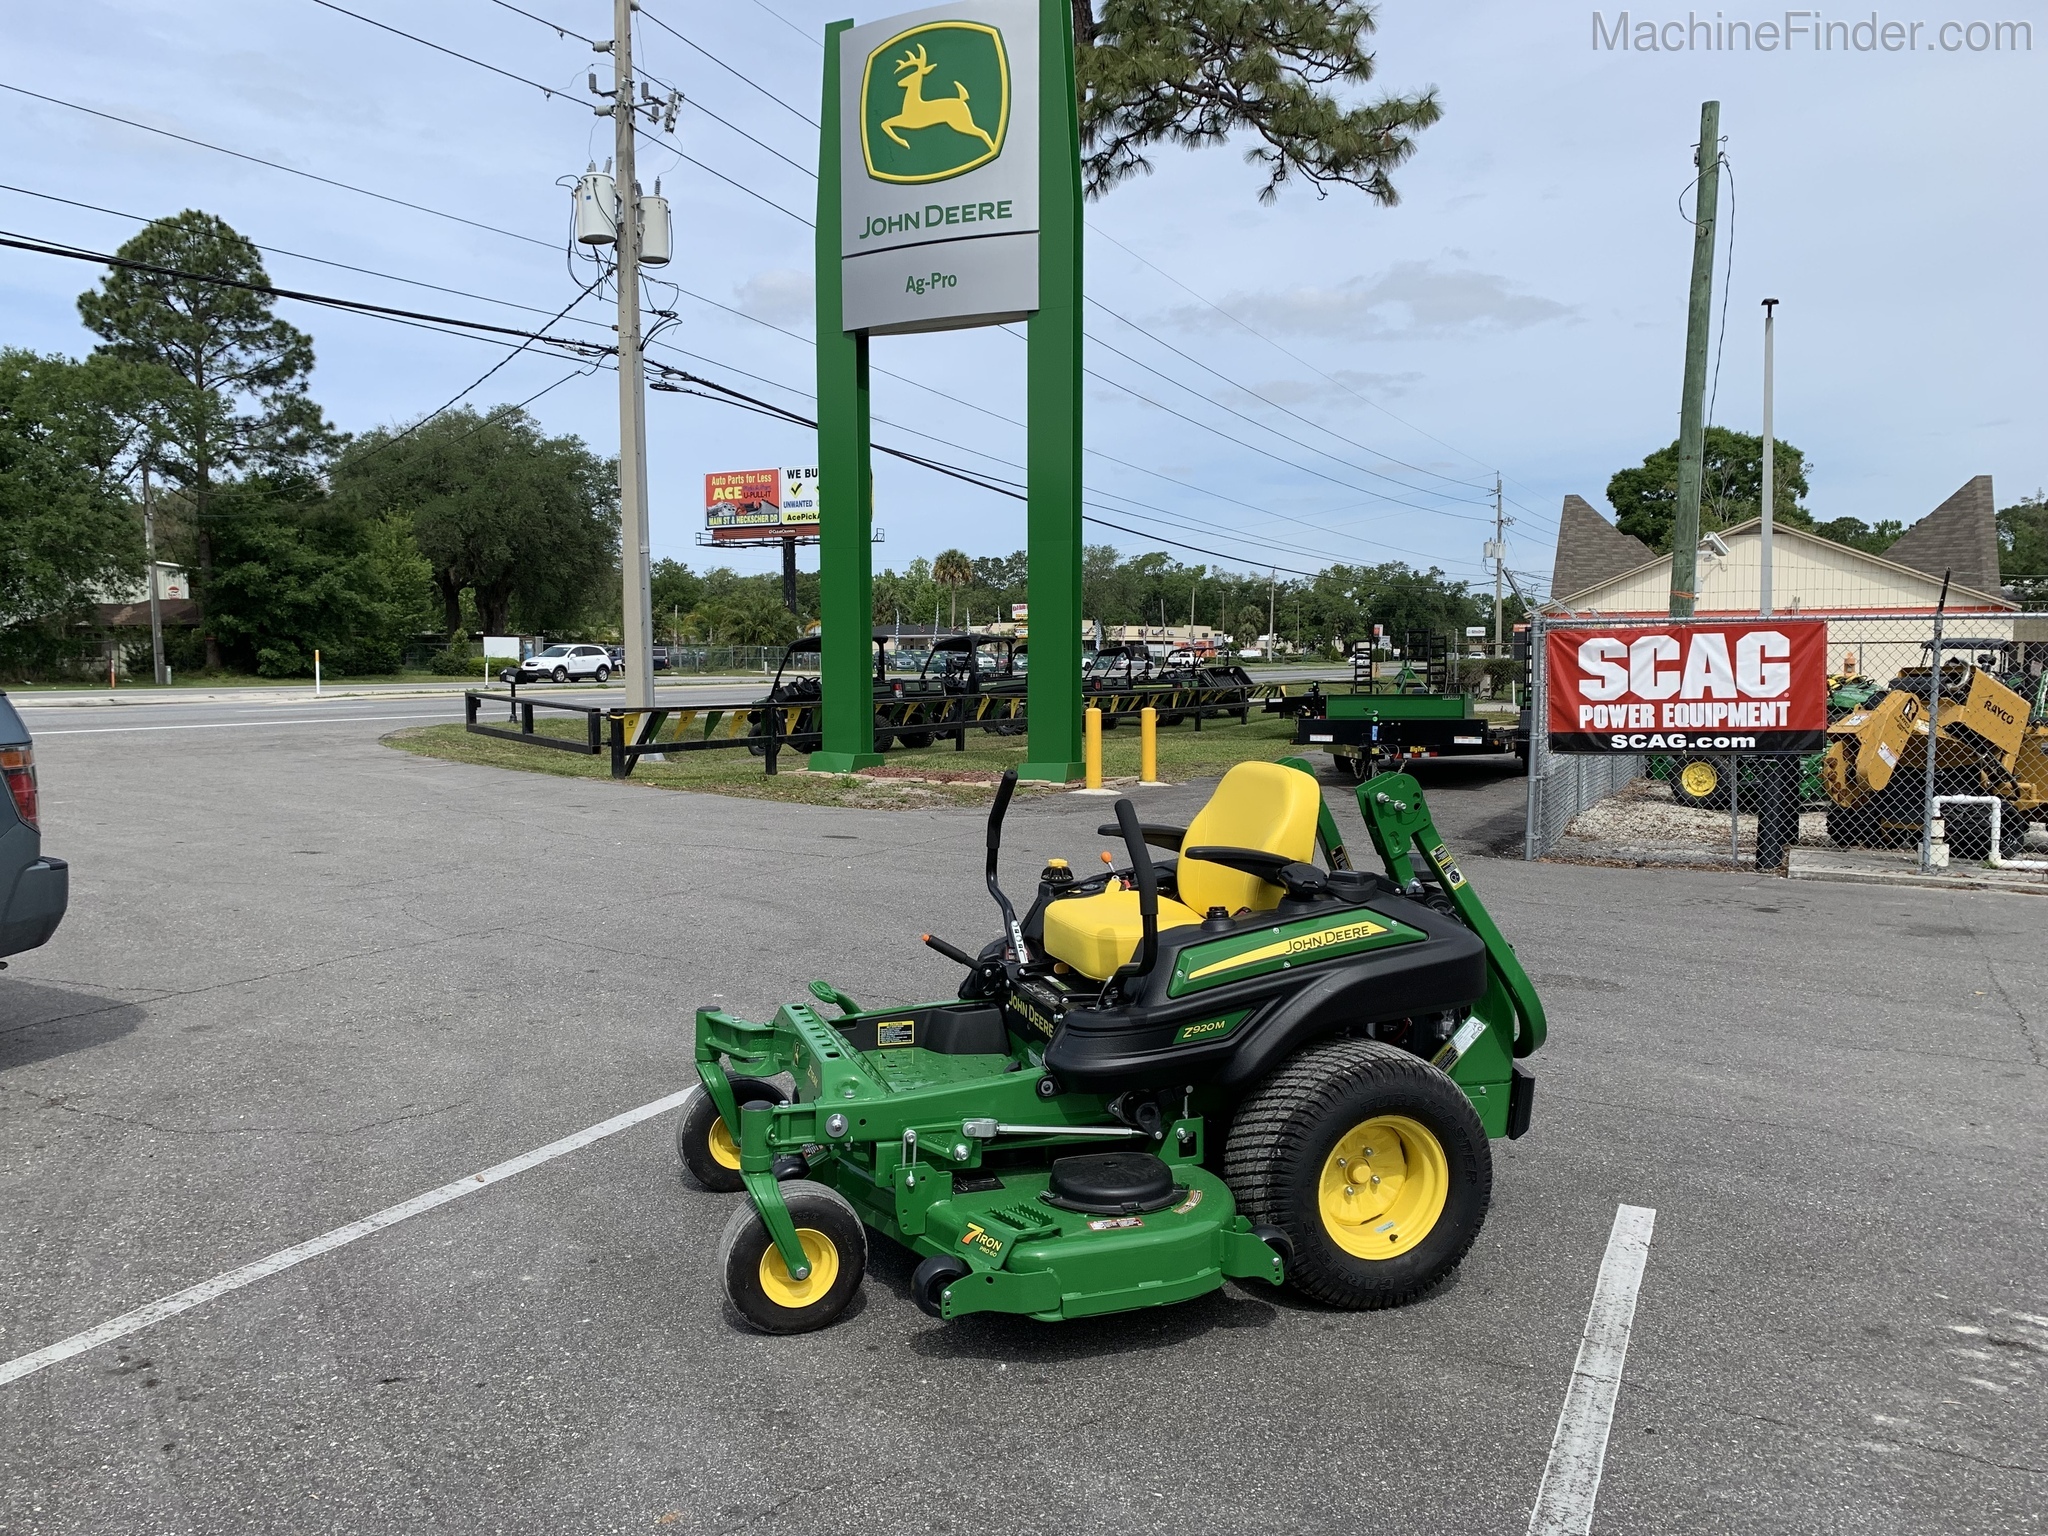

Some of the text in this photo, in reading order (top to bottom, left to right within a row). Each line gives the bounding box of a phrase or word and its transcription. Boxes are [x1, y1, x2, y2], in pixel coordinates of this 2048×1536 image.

[859, 199, 1013, 240] JOHN DEERE
[905, 272, 957, 295] Ag-Pro
[711, 473, 772, 486] Auto Parts for Less
[786, 468, 818, 479] WE BU
[712, 486, 743, 501] ACE
[783, 499, 813, 509] UNWANTED
[709, 517, 723, 526] MAIN
[723, 516, 730, 525] ST
[736, 514, 769, 525] HECKSCHER
[770, 514, 779, 523] DR
[1578, 630, 1790, 701] SCAG
[1579, 700, 1791, 729] POWER EQUIPMENT
[1983, 699, 2015, 725] RAYCO
[1611, 733, 1756, 749] SCAG.com
[1285, 925, 1370, 955] JOHN DEERE
[1008, 990, 1028, 1018] JOHN
[1028, 1004, 1054, 1038] DEERE
[1182, 1020, 1225, 1039] Z920M
